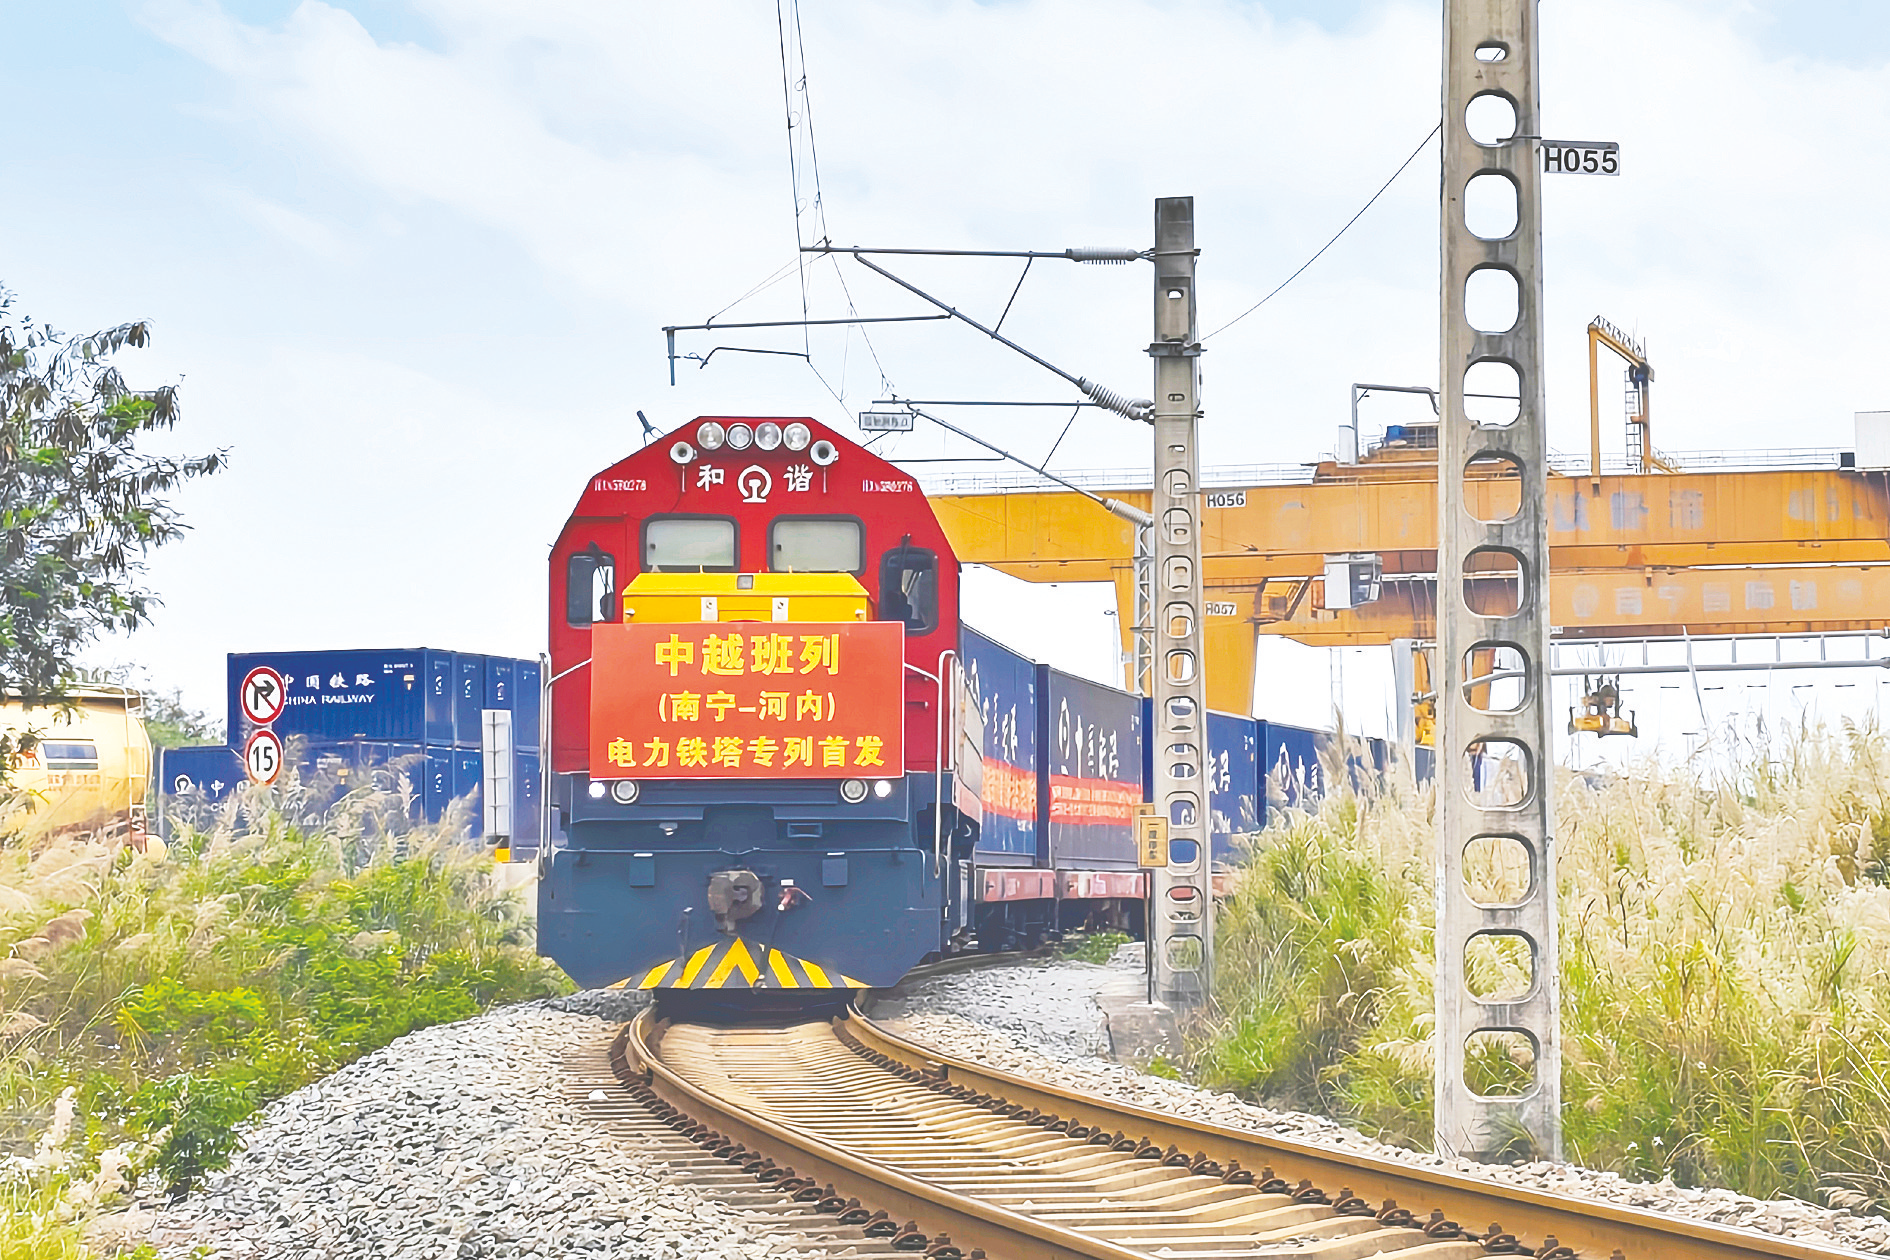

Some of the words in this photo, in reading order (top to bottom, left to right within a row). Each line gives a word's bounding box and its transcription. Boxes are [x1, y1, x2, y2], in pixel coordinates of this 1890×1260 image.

[1544, 147, 1618, 174] H055
[696, 464, 725, 492] 和
[783, 464, 813, 492] 谐
[654, 633, 840, 677] 中越班列
[321, 693, 376, 705] RAILWAY
[252, 745, 274, 772] 15
[607, 735, 886, 768] 电力铁塔专列首发
